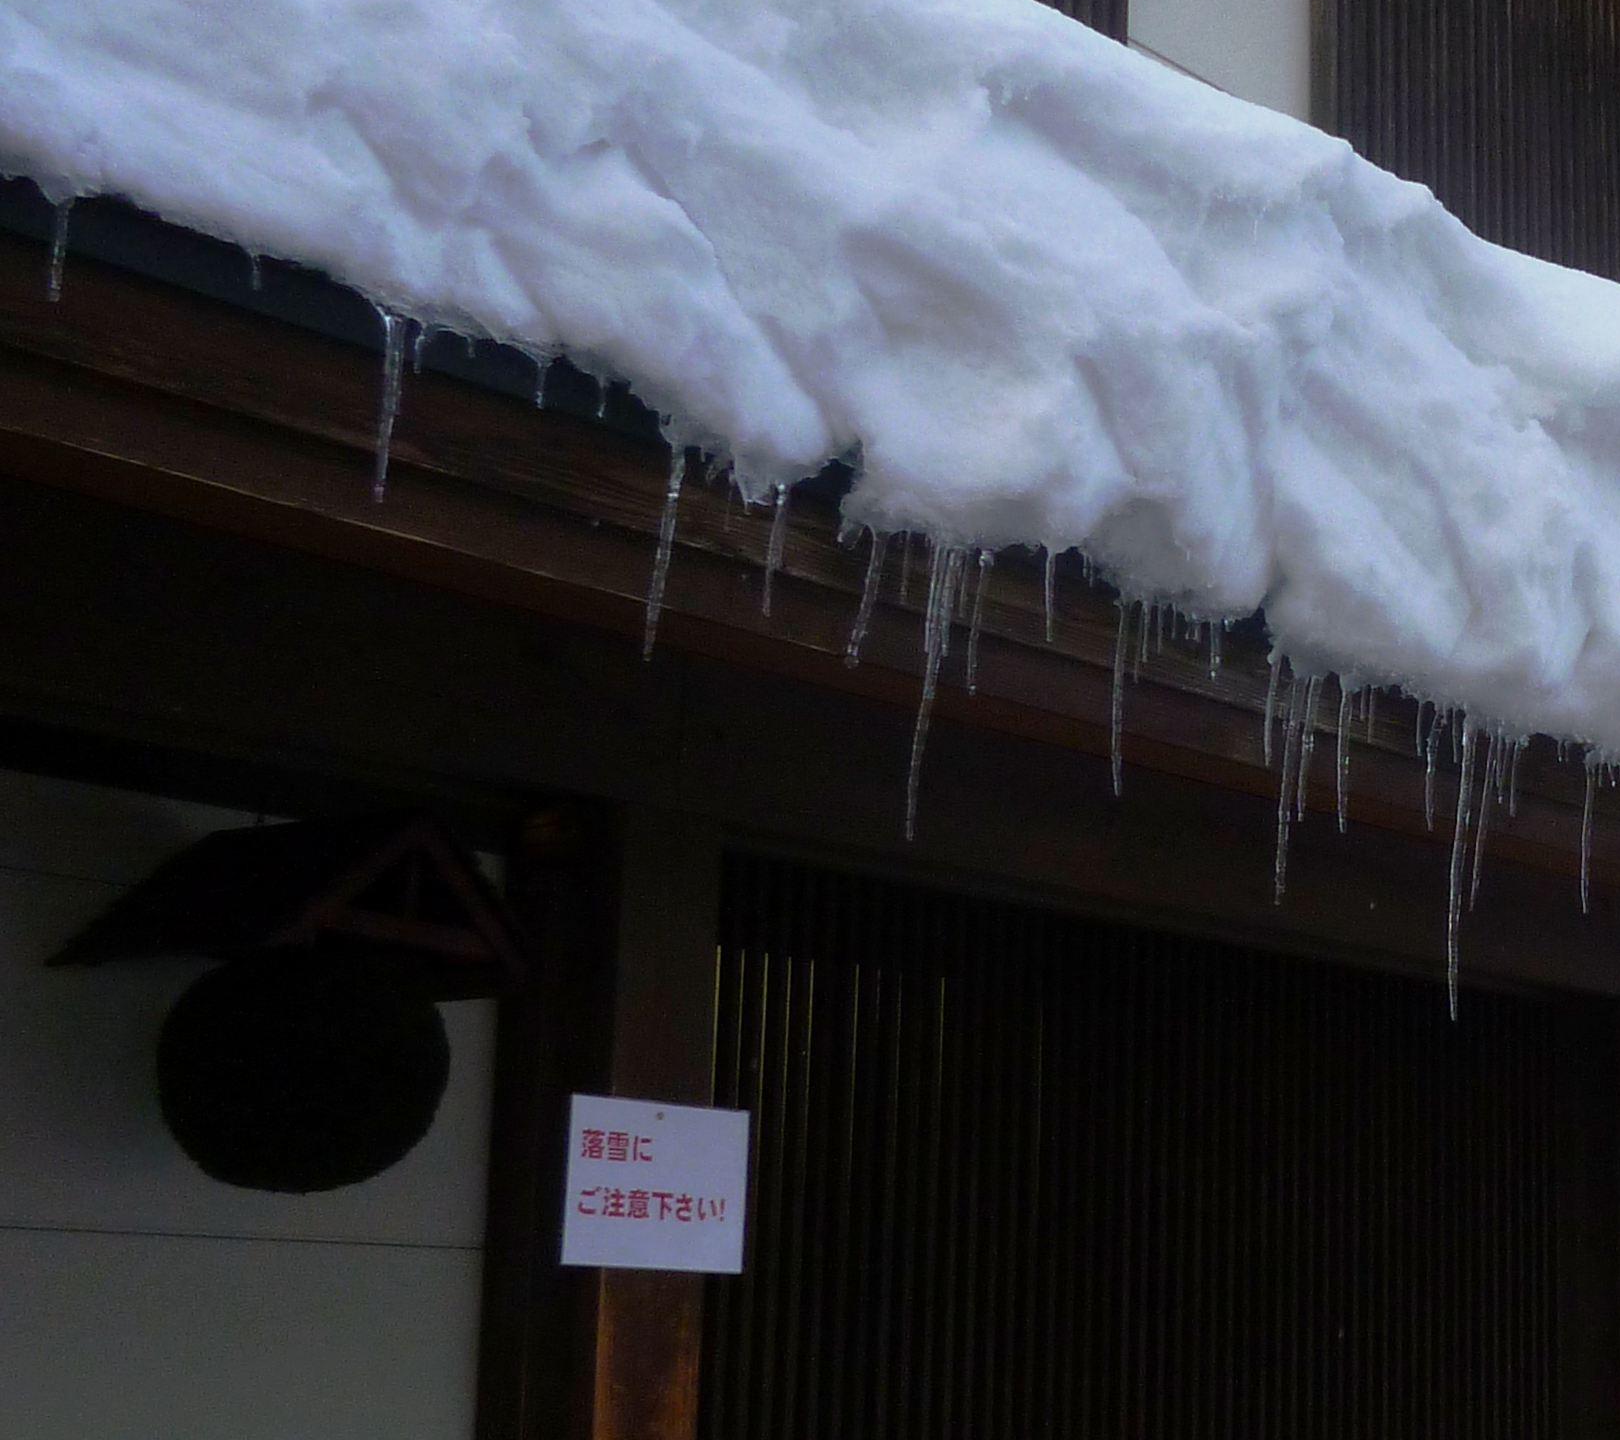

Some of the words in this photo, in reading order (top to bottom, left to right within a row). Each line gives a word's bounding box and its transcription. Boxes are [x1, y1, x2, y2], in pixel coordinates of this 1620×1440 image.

[581, 1129, 653, 1162] 落雪に
[577, 1186, 726, 1222] ご注意下さい!
